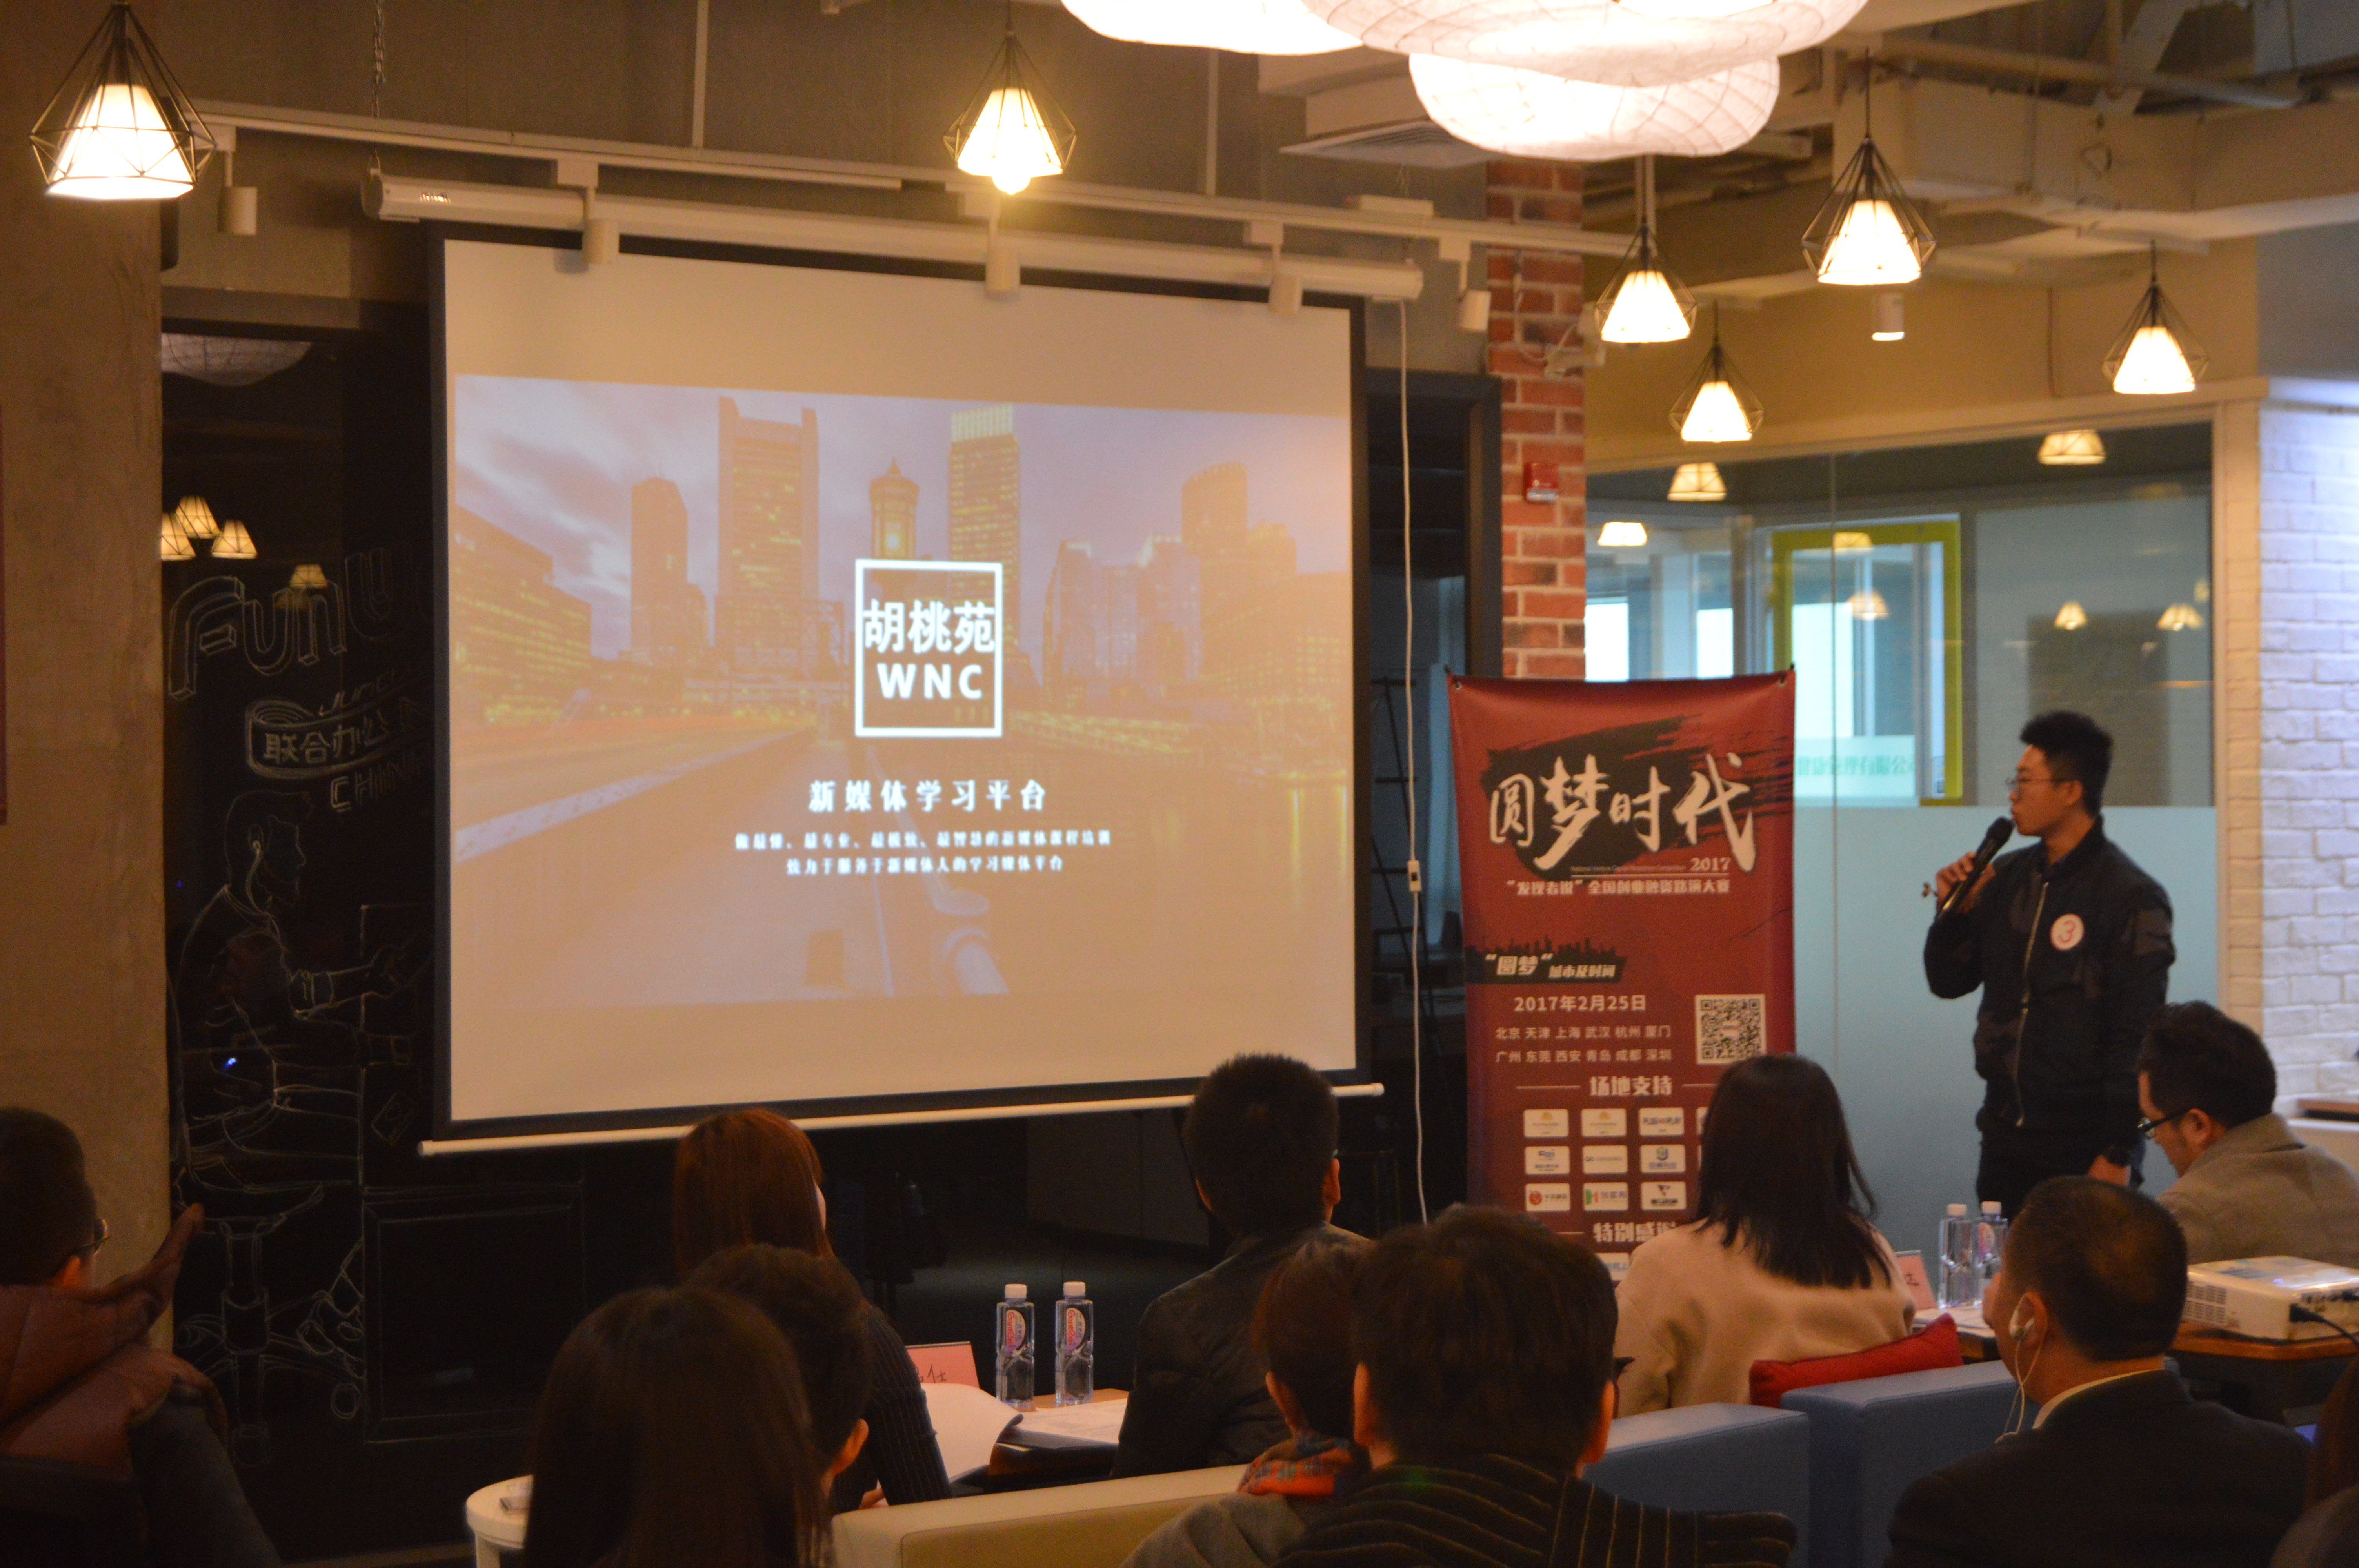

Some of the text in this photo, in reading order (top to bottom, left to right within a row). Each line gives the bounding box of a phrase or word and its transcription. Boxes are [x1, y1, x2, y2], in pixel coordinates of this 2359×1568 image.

[863, 599, 996, 654] 胡桃苑
[876, 662, 983, 700] WNC
[809, 779, 1046, 812] 新媒体学习平台
[1490, 752, 1756, 872] 圆梦时代
[1690, 858, 1730, 872] 2017
[2058, 920, 2077, 943] 3
[1514, 995, 1647, 1013] 2017年2月25日
[1495, 1025, 1671, 1040] 北京 天津 上海 武汉 杭州 厦门
[1495, 1048, 1672, 1063] 广州 东莞 西安 青岛 成都 深圳
[1589, 1075, 1673, 1097] 场地支持
